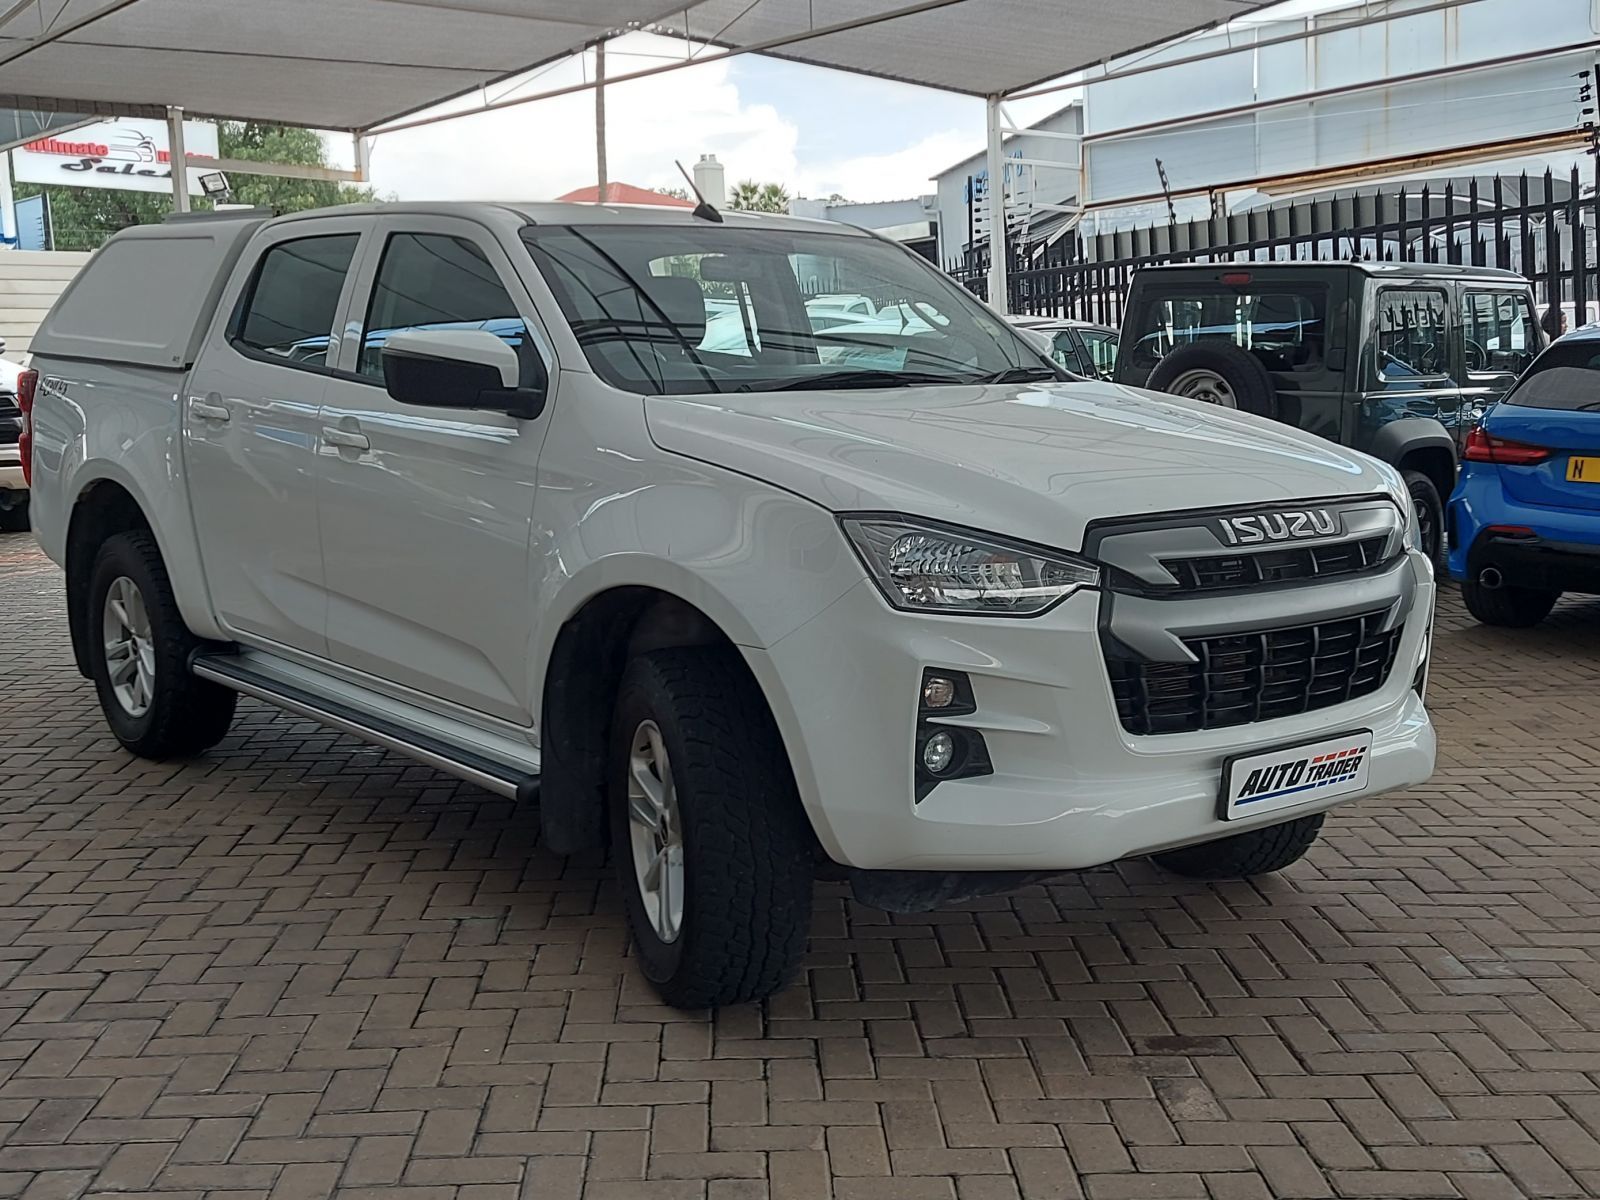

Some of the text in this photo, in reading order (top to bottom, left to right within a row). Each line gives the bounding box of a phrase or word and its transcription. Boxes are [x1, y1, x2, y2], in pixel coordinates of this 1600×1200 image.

[1572, 459, 1584, 479] N
[1218, 509, 1336, 544] ISUZU
[1237, 755, 1363, 798] AUTO TRADER
